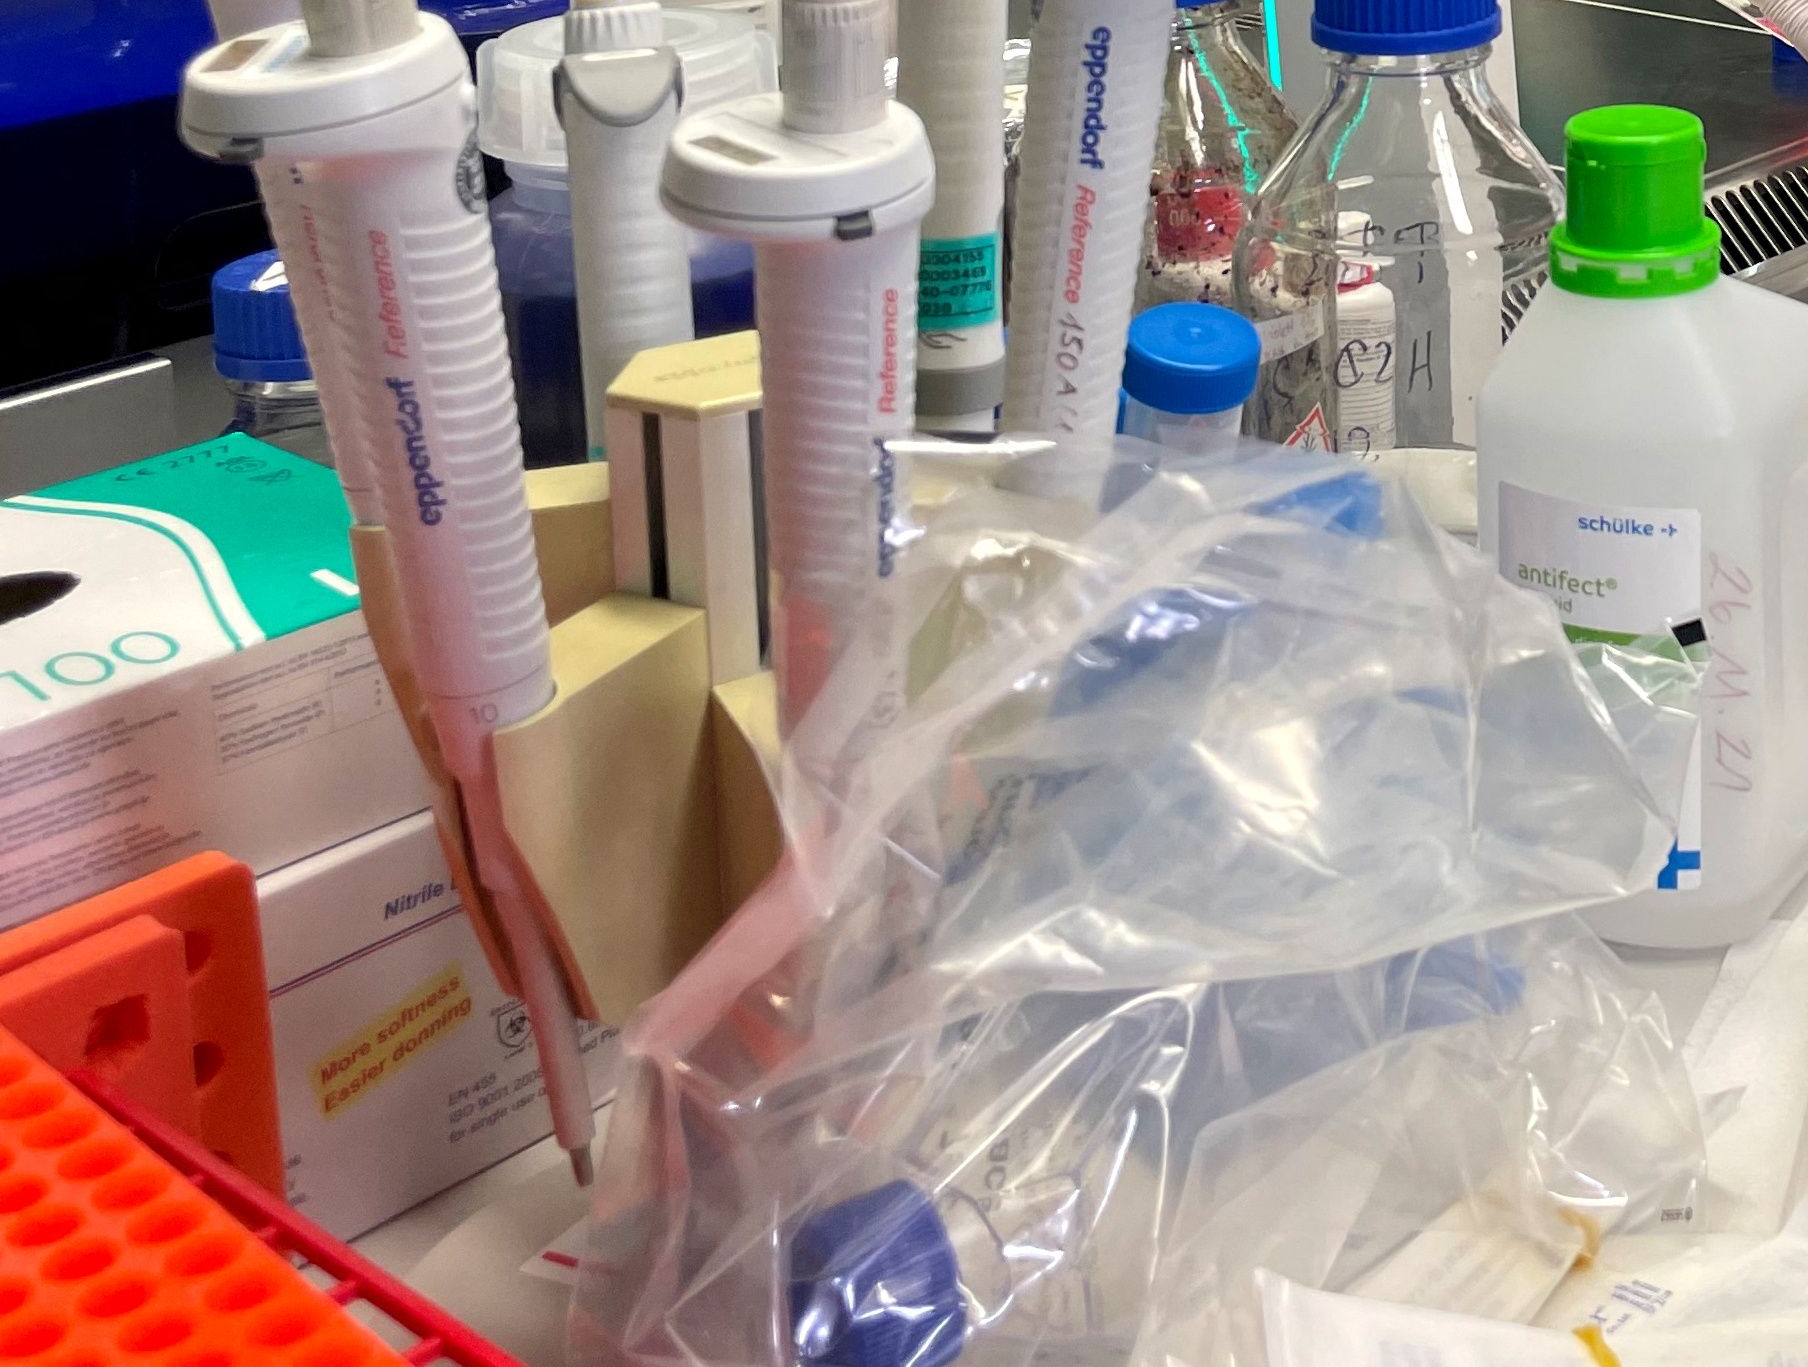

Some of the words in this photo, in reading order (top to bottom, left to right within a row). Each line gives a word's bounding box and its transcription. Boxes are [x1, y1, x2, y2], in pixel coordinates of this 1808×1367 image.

[1079, 26, 1112, 169] eppendorf
[369, 229, 408, 360] Reference
[1063, 184, 1096, 304] Reference
[877, 288, 898, 414] Reference
[385, 376, 447, 527] eppendorf
[1578, 515, 1654, 537] schülke
[0, 631, 181, 702] 100
[383, 882, 444, 920] Nitrile
[320, 1042, 372, 1085] More
[377, 976, 461, 1044] softness
[323, 1057, 386, 1113] Easier
[392, 996, 472, 1062] donning
